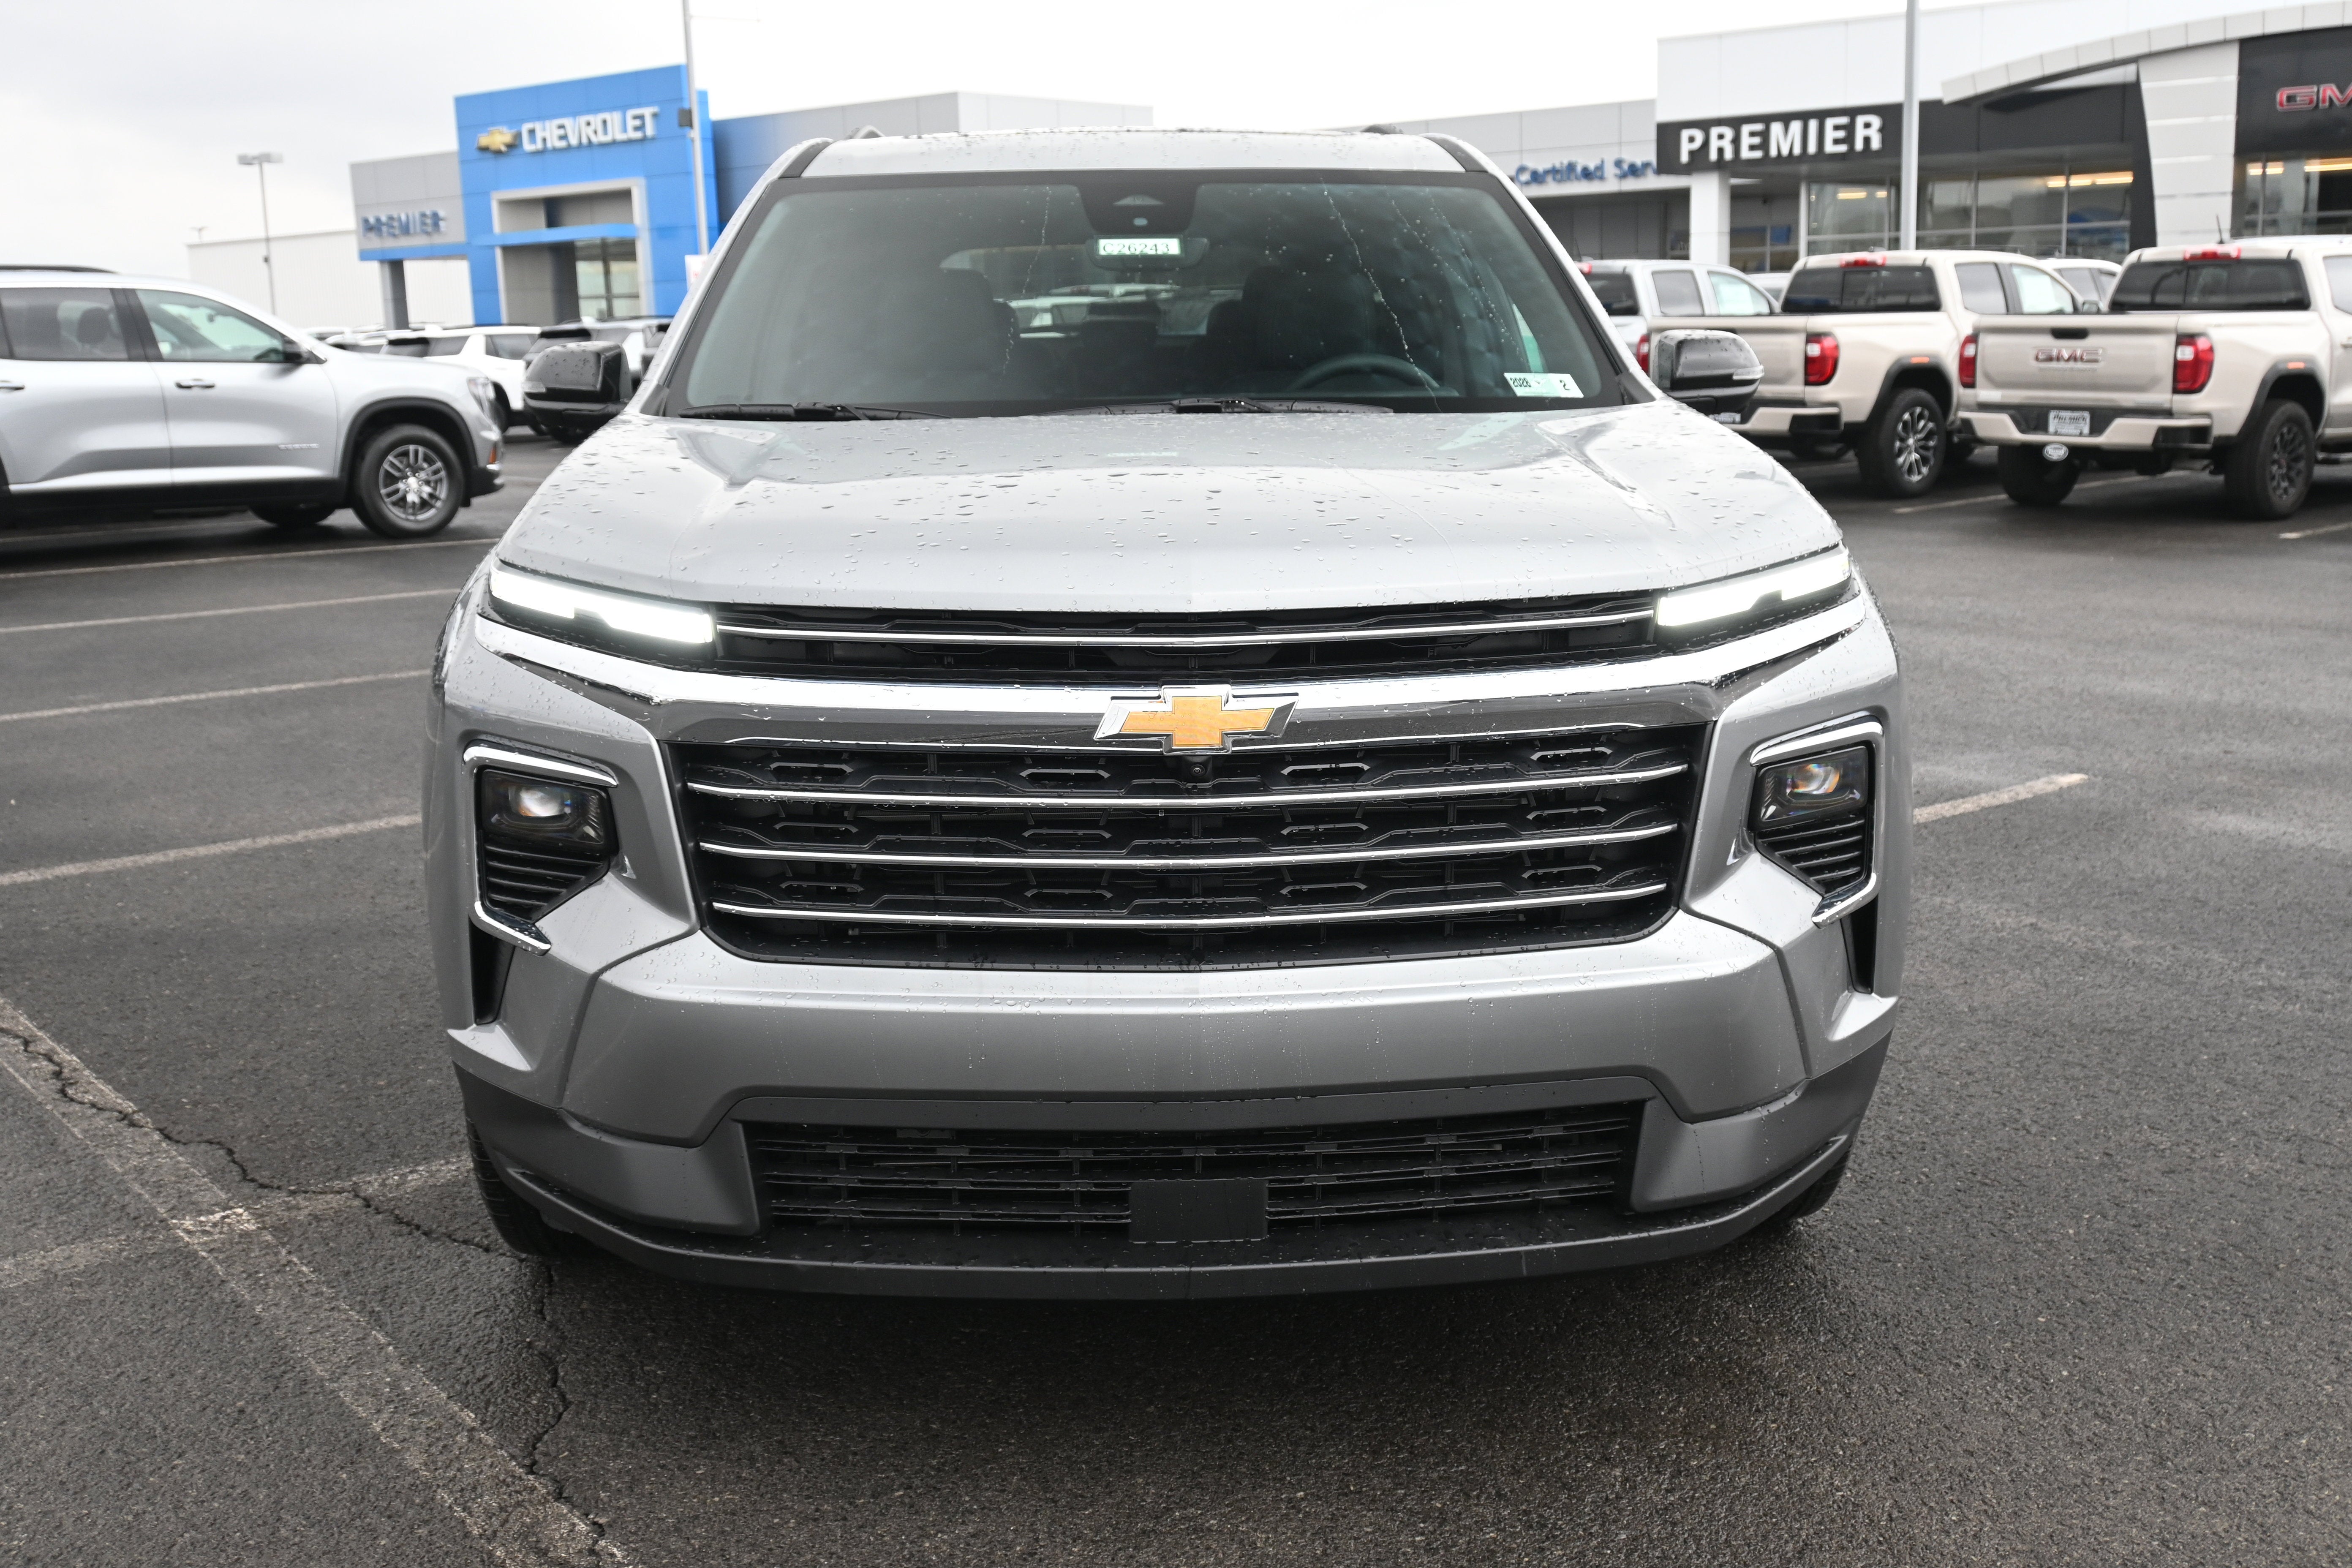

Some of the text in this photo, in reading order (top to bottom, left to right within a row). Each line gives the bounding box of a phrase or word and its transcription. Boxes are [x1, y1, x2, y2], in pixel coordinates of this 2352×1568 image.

[522, 106, 660, 152] CHEVROLET
[1680, 114, 1883, 164] PREMIER
[1516, 158, 1605, 185] Certified
[362, 210, 446, 238] PREMIER
[1103, 242, 1170, 254] C26243
[2035, 348, 2102, 362] GMC
[1560, 379, 1571, 390] 2
